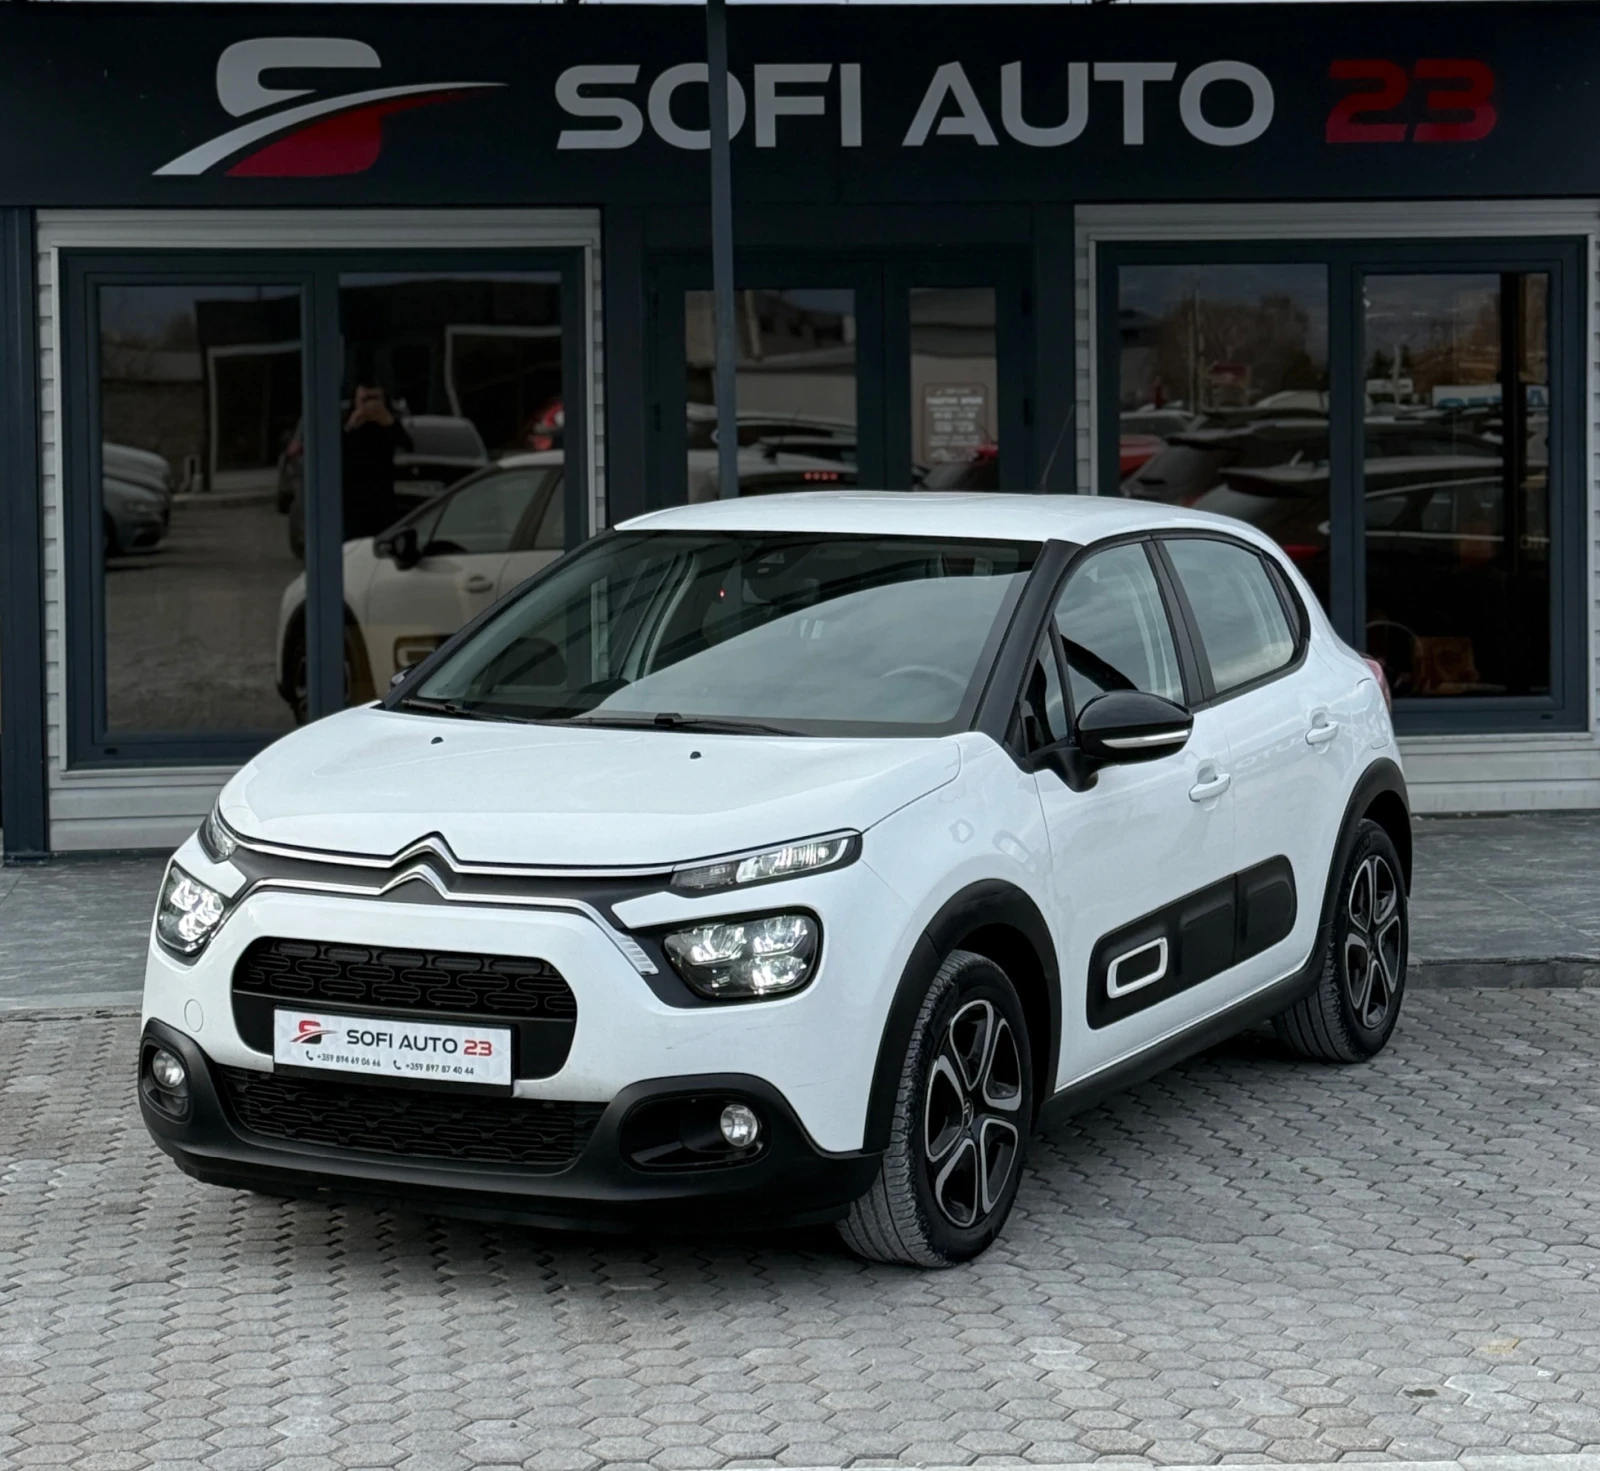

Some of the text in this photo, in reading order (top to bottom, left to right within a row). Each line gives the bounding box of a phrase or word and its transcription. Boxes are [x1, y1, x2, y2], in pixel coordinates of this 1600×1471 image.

[555, 58, 1497, 150] SOFI AUTO 23
[346, 1029, 493, 1057] SOFI AUTO 23
